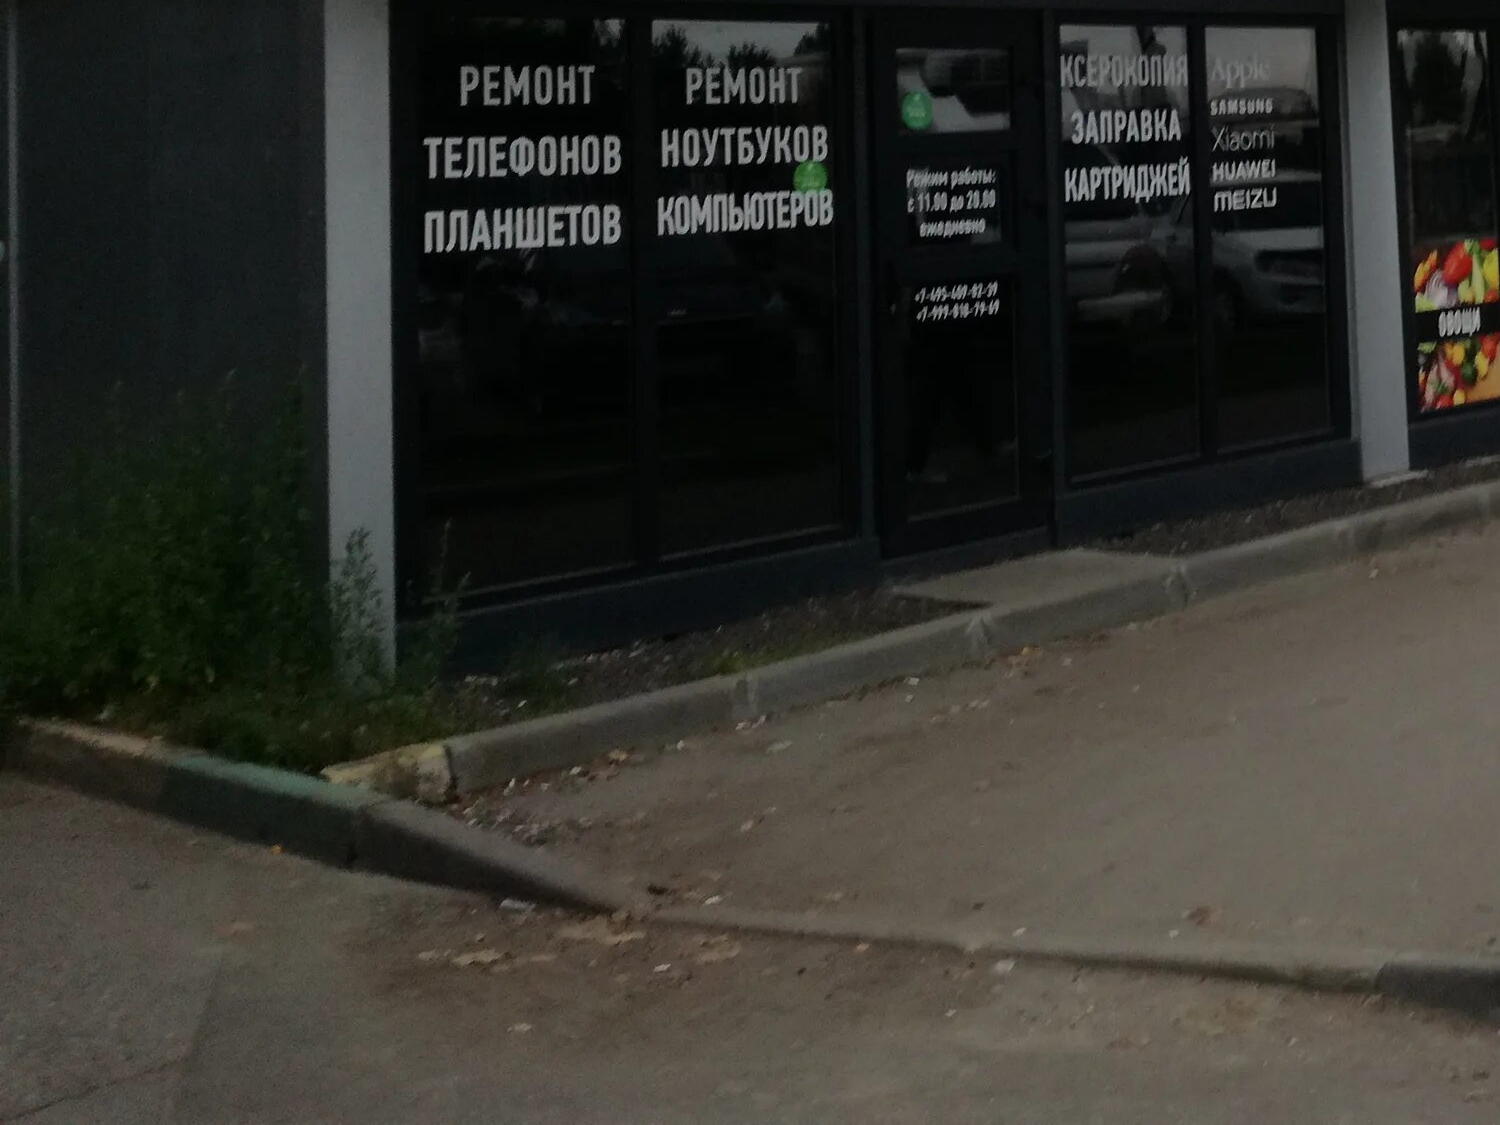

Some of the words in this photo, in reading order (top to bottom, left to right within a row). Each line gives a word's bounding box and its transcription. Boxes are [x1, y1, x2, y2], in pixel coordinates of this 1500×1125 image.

[459, 63, 596, 107] РЕМОНТ
[684, 65, 803, 105] РЕМОНТ
[1060, 52, 1189, 88] КСЕРОКОПИЯ
[1209, 52, 1271, 88] Apple
[1209, 97, 1274, 116] SAMSUNG
[1071, 108, 1182, 145] ЗАПРАВКА
[1210, 123, 1276, 152] Xiaomi
[422, 133, 623, 180] ТЕЛЕФОНОВ
[660, 124, 830, 168] НОУТБУКОВ
[1064, 156, 1191, 204] КАРТРИДЖЕЙ
[1212, 158, 1277, 182] HUAWEI
[656, 188, 834, 236] КОМПЬЮТЕРОВ
[1213, 186, 1278, 213] MEIZU
[422, 201, 623, 254] ПЛАНШЕТОВ
[1438, 306, 1481, 337] ОВОЩИ
